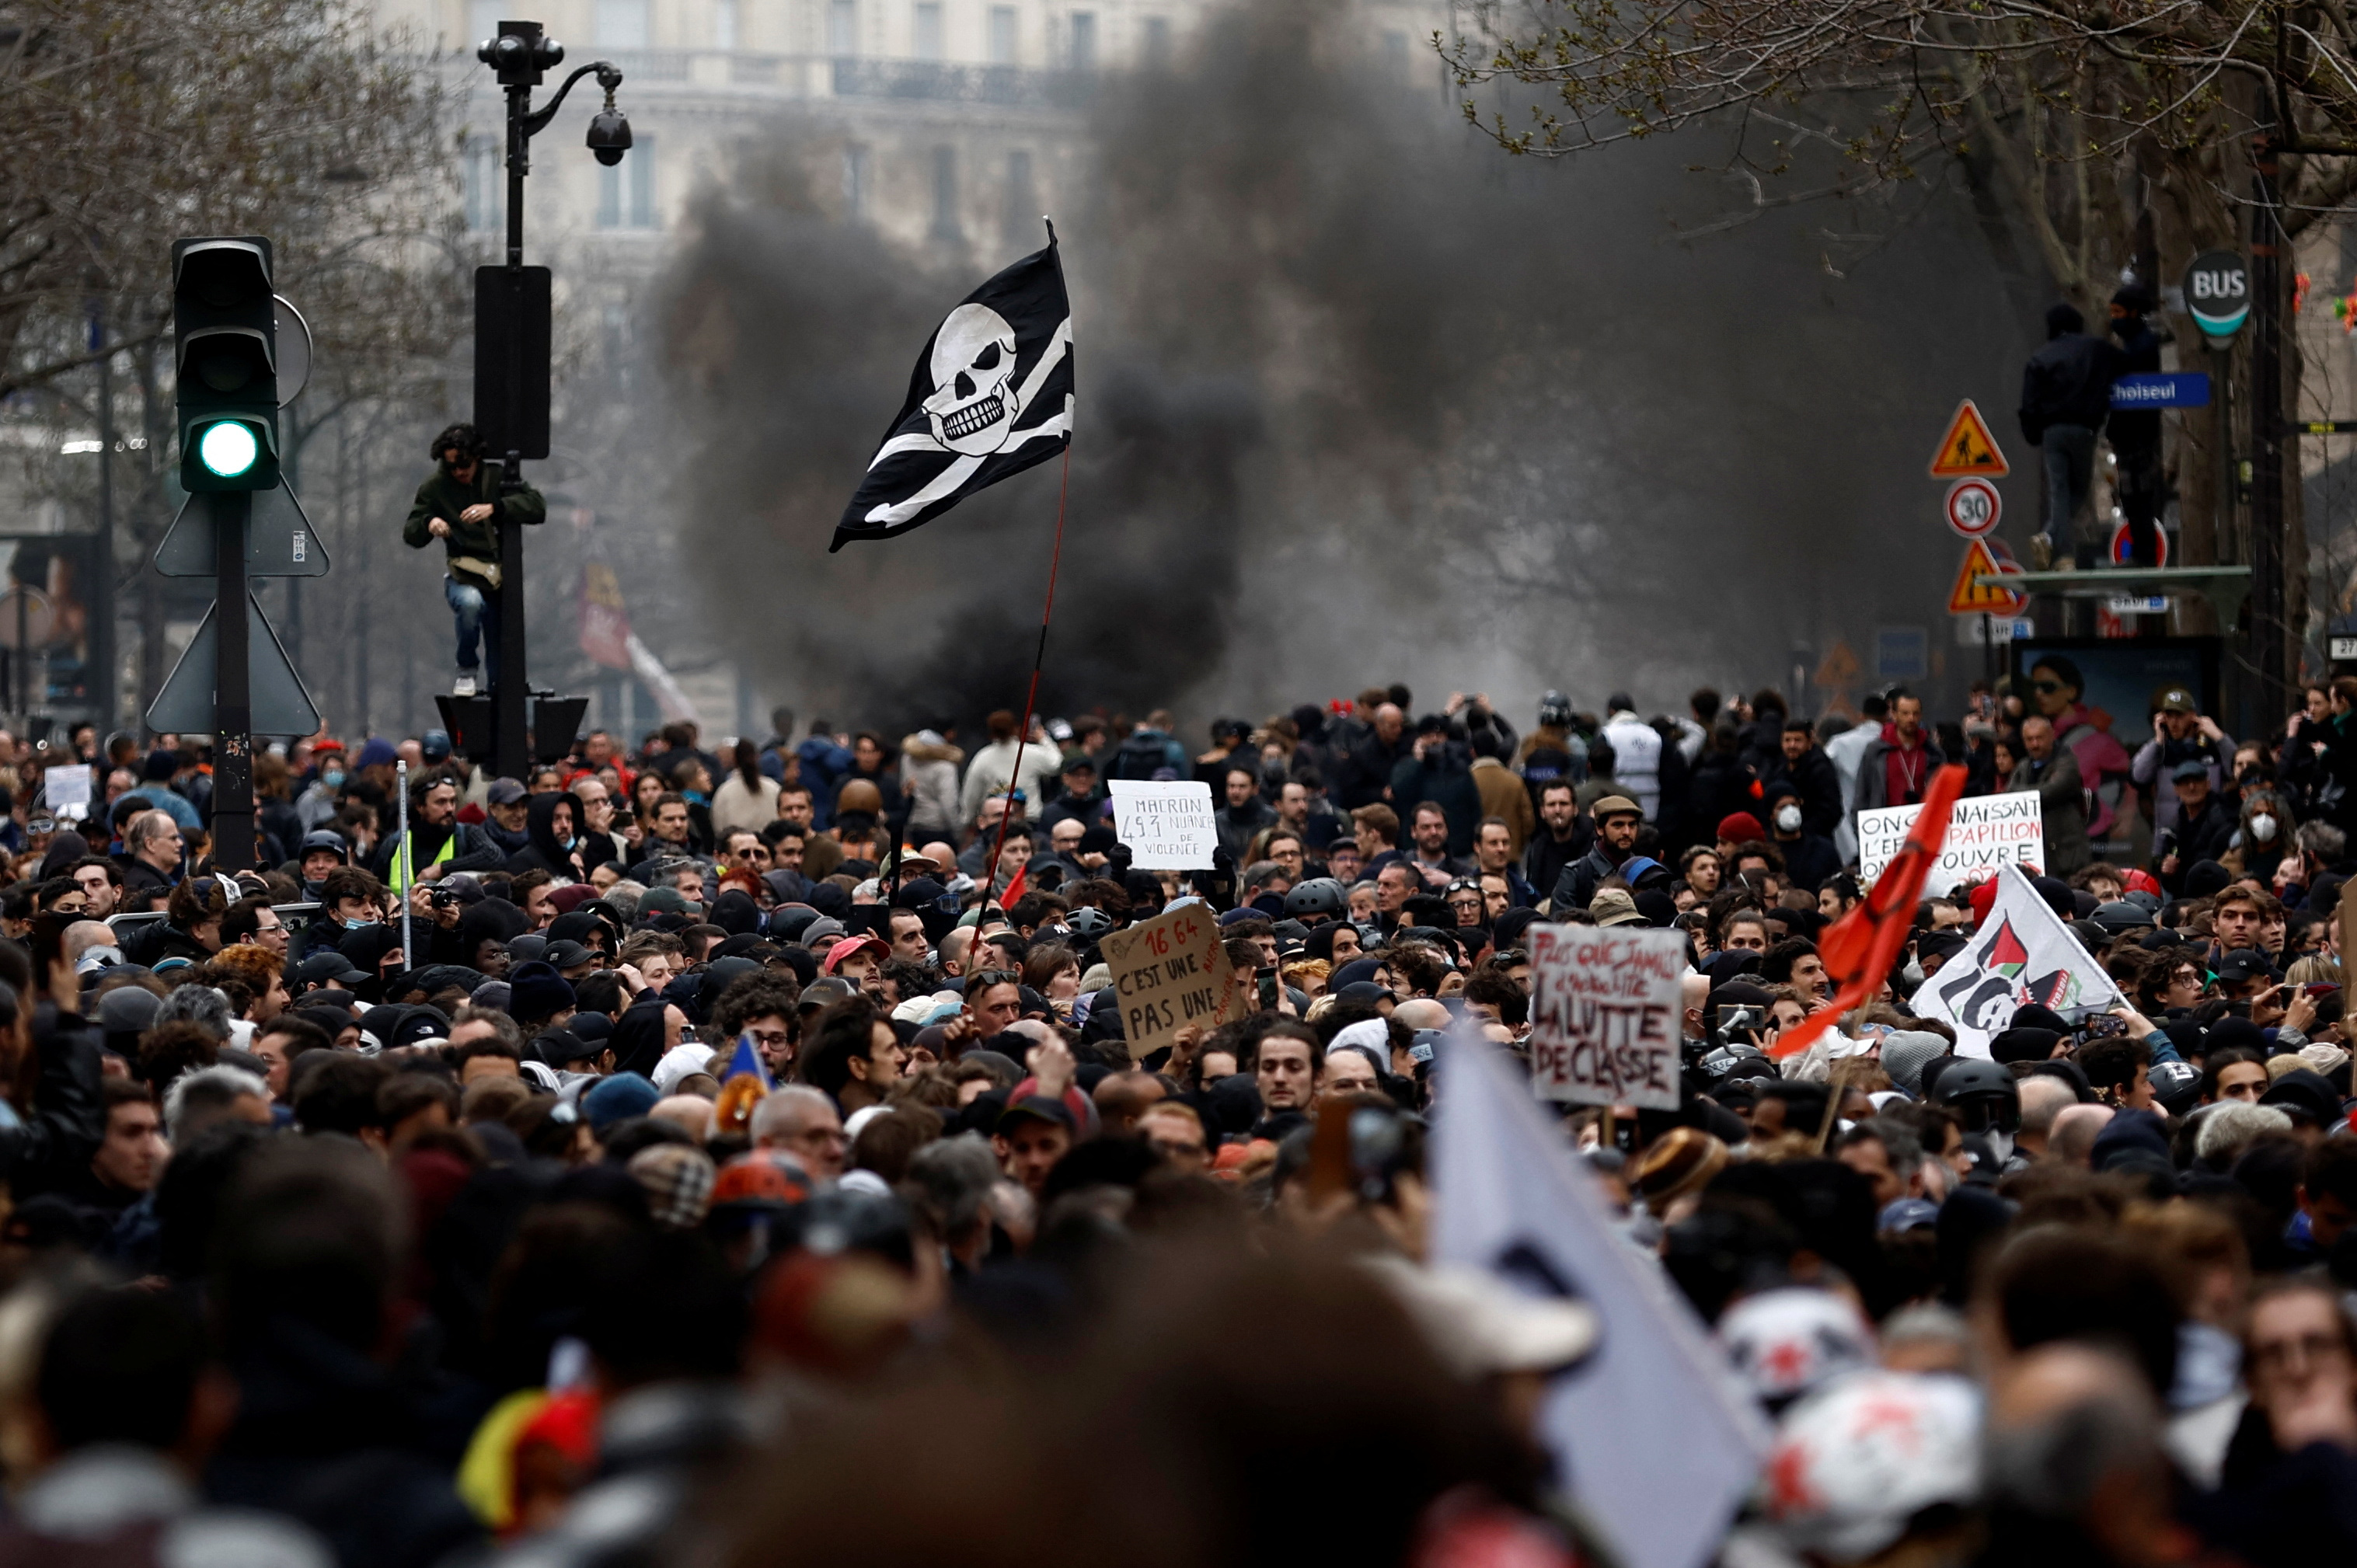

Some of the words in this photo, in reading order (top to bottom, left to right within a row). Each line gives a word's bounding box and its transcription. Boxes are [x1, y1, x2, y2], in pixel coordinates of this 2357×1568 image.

[2192, 270, 2246, 299] BUS
[1961, 493, 1988, 522] 30
[1135, 798, 1202, 814] MACRON
[1180, 833, 1194, 842] DE
[1949, 821, 2041, 846] PAPILLON
[1145, 843, 1201, 855] VIOLENCE
[1119, 963, 1161, 996] C'EST
[1165, 953, 1198, 981] UNE
[1129, 998, 1174, 1040] PAS
[1181, 987, 1218, 1021] UNE
